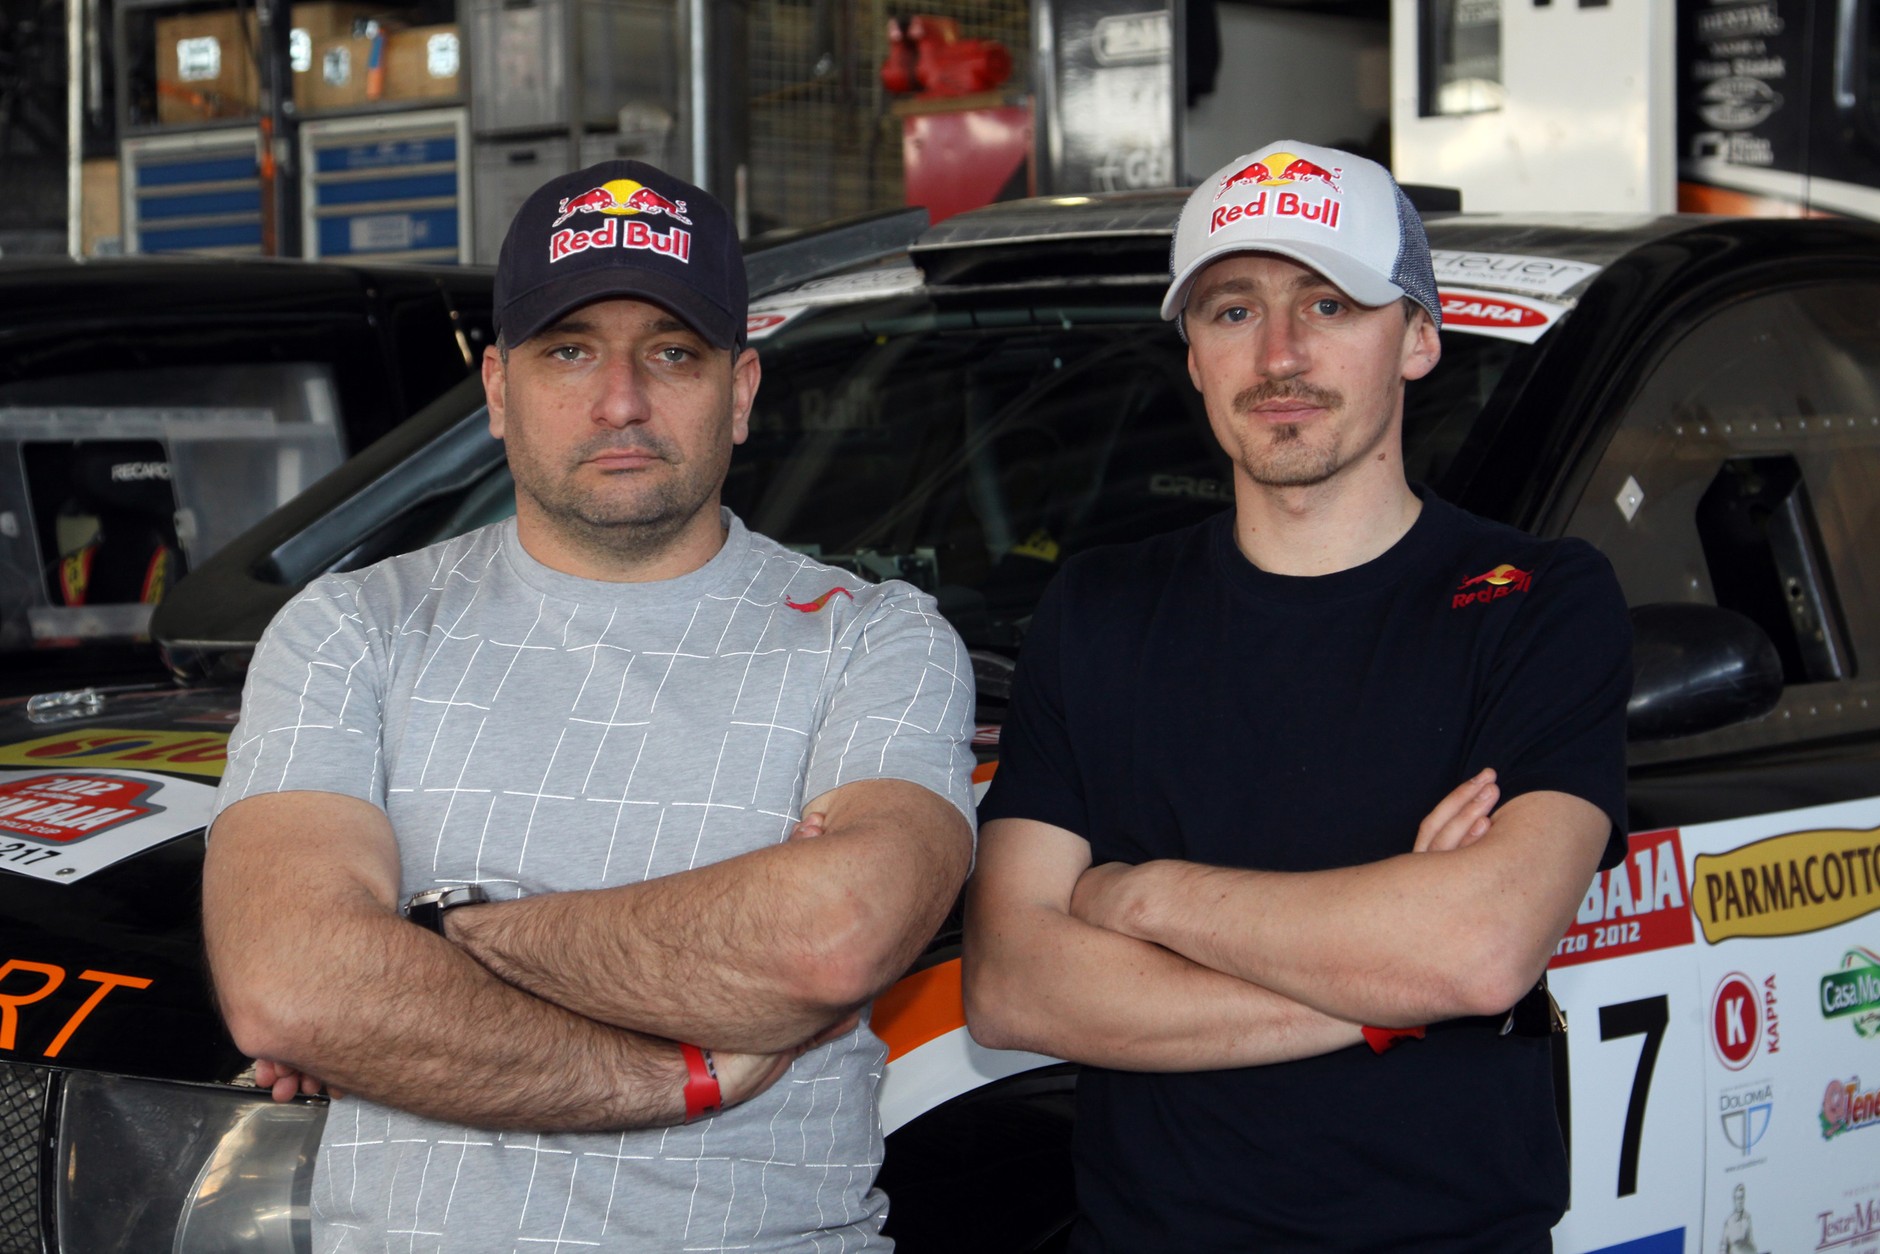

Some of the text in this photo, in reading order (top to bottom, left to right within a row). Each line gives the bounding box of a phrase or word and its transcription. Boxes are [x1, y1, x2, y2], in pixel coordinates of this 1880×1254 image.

[1208, 190, 1341, 237] Red Bull
[550, 218, 691, 263] Red Bull
[1439, 299, 1523, 324] ZARA
[1451, 585, 1494, 609] Red
[25, 778, 125, 797] 2012
[14, 802, 137, 831] BAJA
[28, 825, 63, 835] CUP
[0, 842, 62, 866] 217
[1552, 920, 1641, 957] rzo 2012
[0, 958, 154, 1058] RT
[1725, 996, 1747, 1047] K
[1764, 973, 1780, 1055] KAPPA
